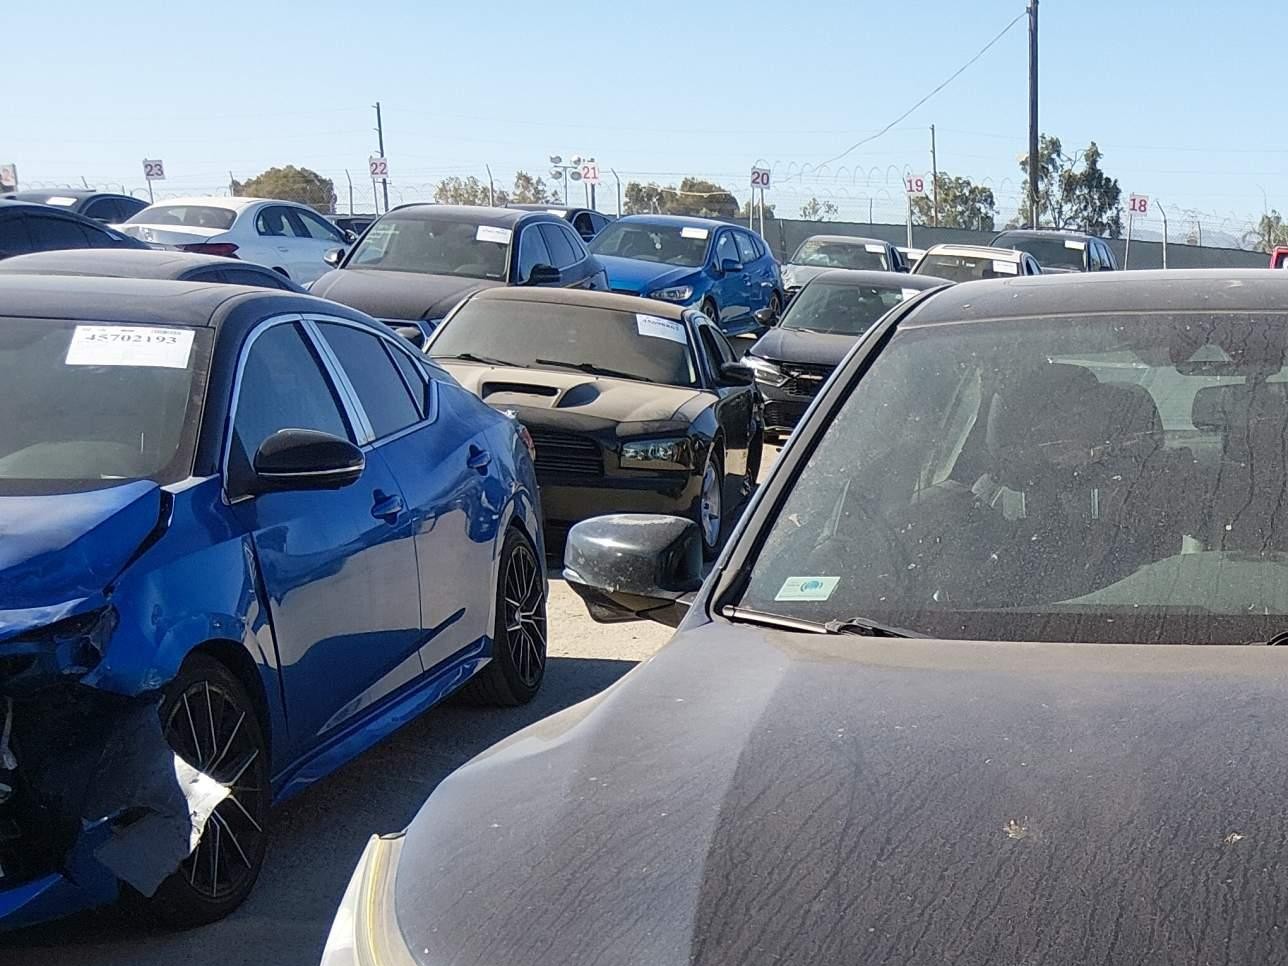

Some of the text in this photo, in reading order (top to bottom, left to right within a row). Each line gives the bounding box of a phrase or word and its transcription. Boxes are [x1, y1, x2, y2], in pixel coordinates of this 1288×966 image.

[145, 164, 163, 176] 23
[370, 162, 387, 175] 22
[582, 166, 598, 180] 21
[752, 171, 770, 186] 20
[907, 179, 923, 192] 19
[1130, 198, 1147, 212] 18
[85, 334, 177, 345] 45702193
